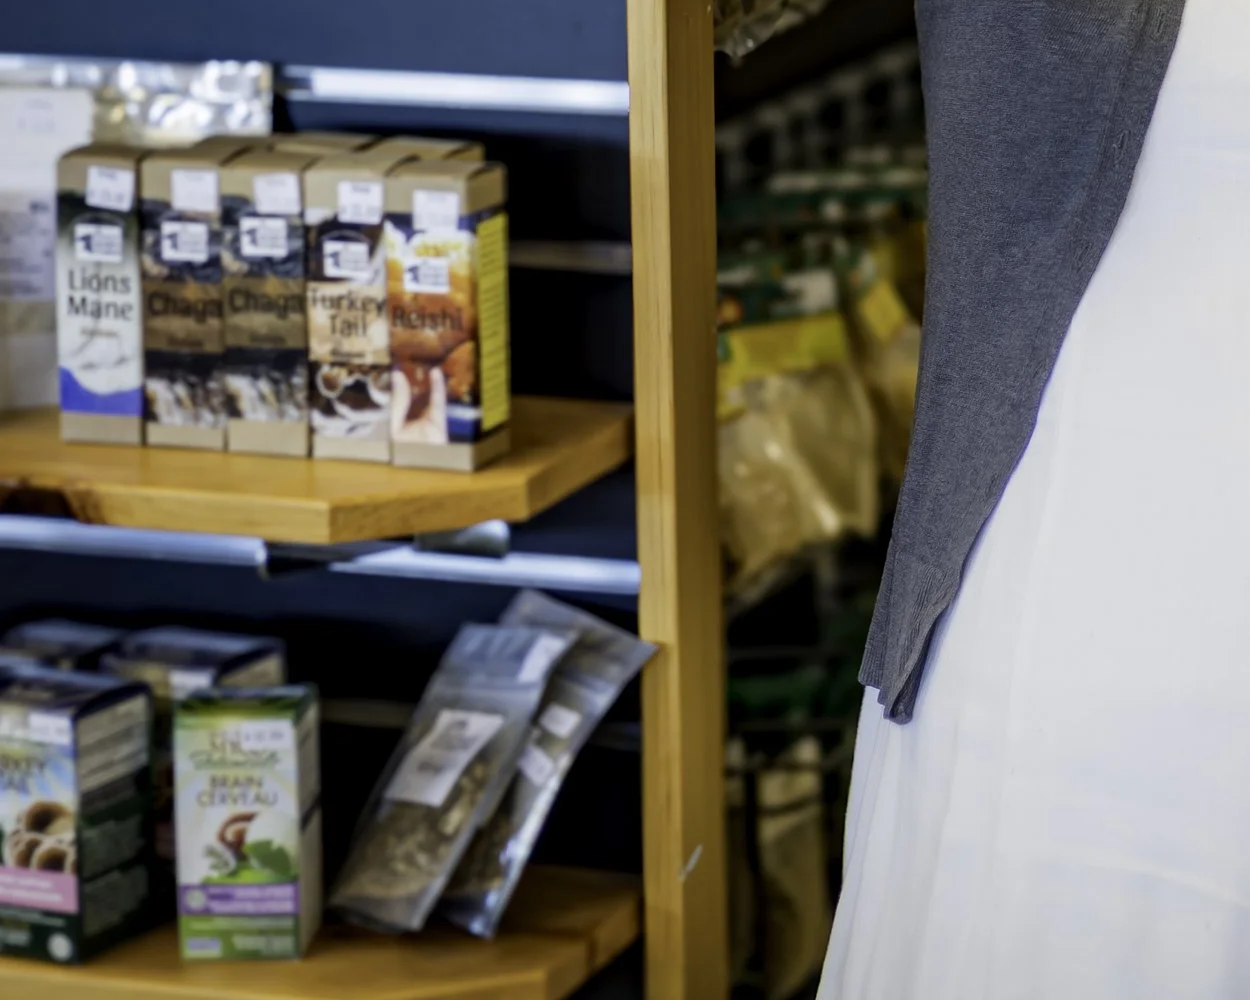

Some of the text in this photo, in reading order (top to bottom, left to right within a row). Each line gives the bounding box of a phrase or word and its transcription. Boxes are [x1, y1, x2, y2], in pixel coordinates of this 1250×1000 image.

[67, 267, 132, 293] Lions
[67, 295, 134, 320] Mane
[329, 314, 367, 337] Tail
